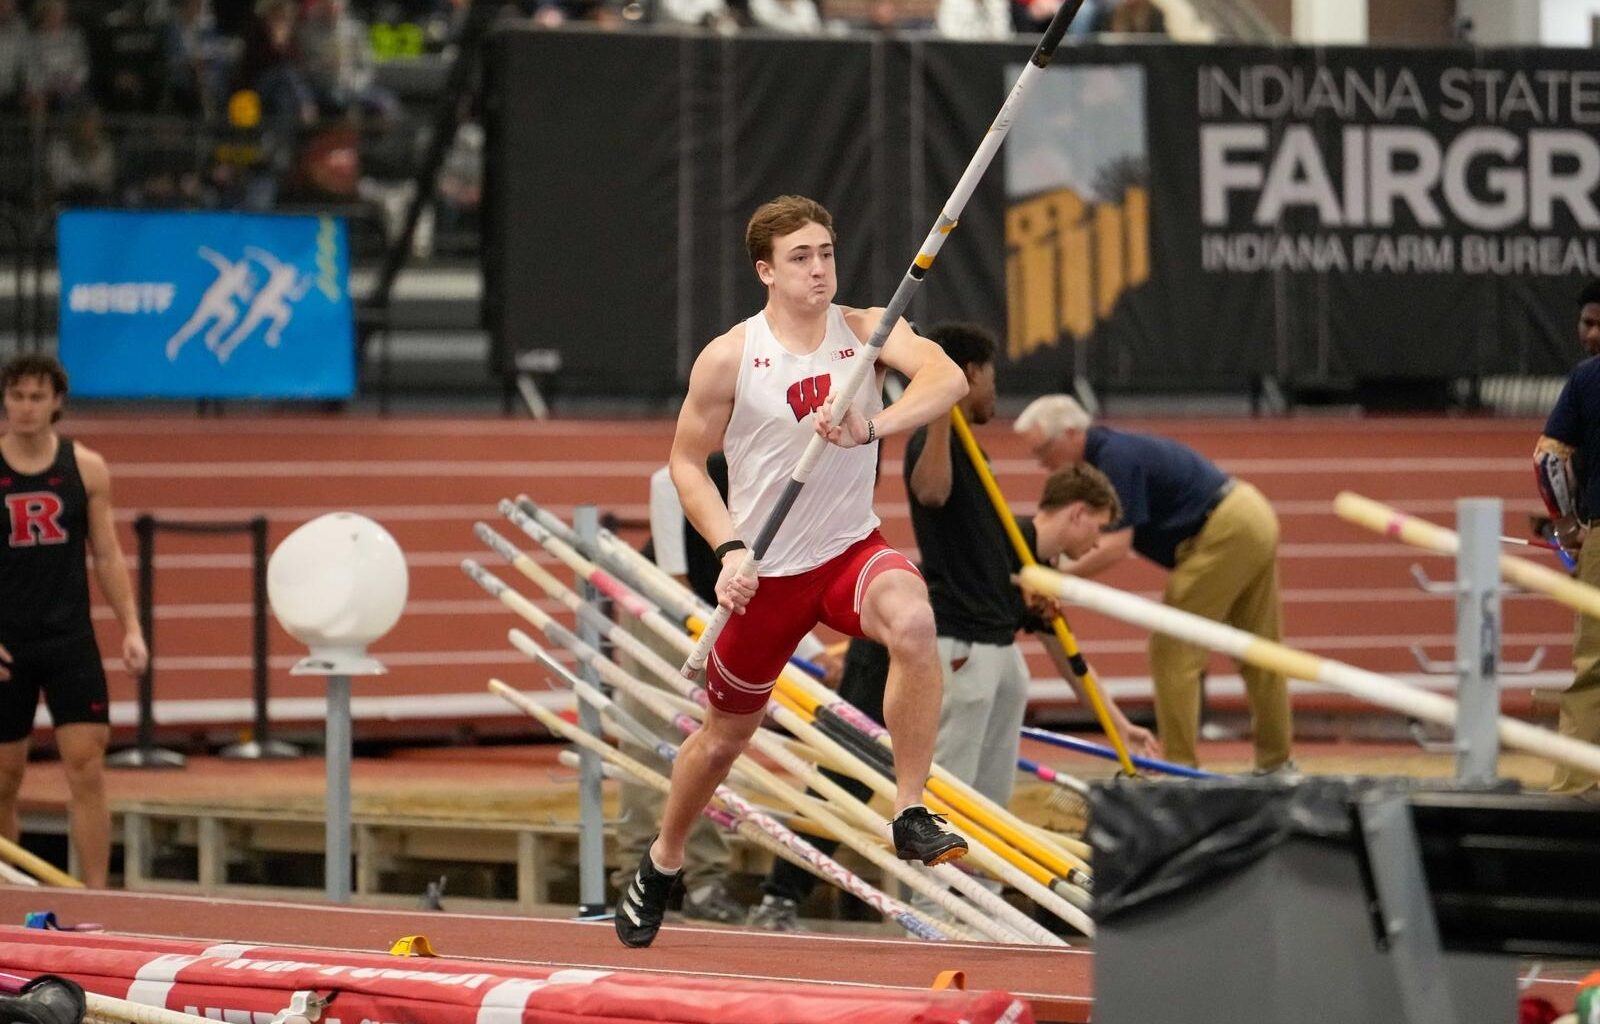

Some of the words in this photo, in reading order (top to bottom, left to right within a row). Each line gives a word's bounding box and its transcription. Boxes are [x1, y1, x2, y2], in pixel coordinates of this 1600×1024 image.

[1198, 64, 1429, 120] INDIANA
[1439, 67, 1600, 124] STATE
[1200, 124, 1600, 230] FAIRGR
[1202, 233, 1349, 272] INDIANA
[1352, 234, 1455, 273] FARM
[786, 373, 832, 423] W
[5, 491, 68, 547] R
